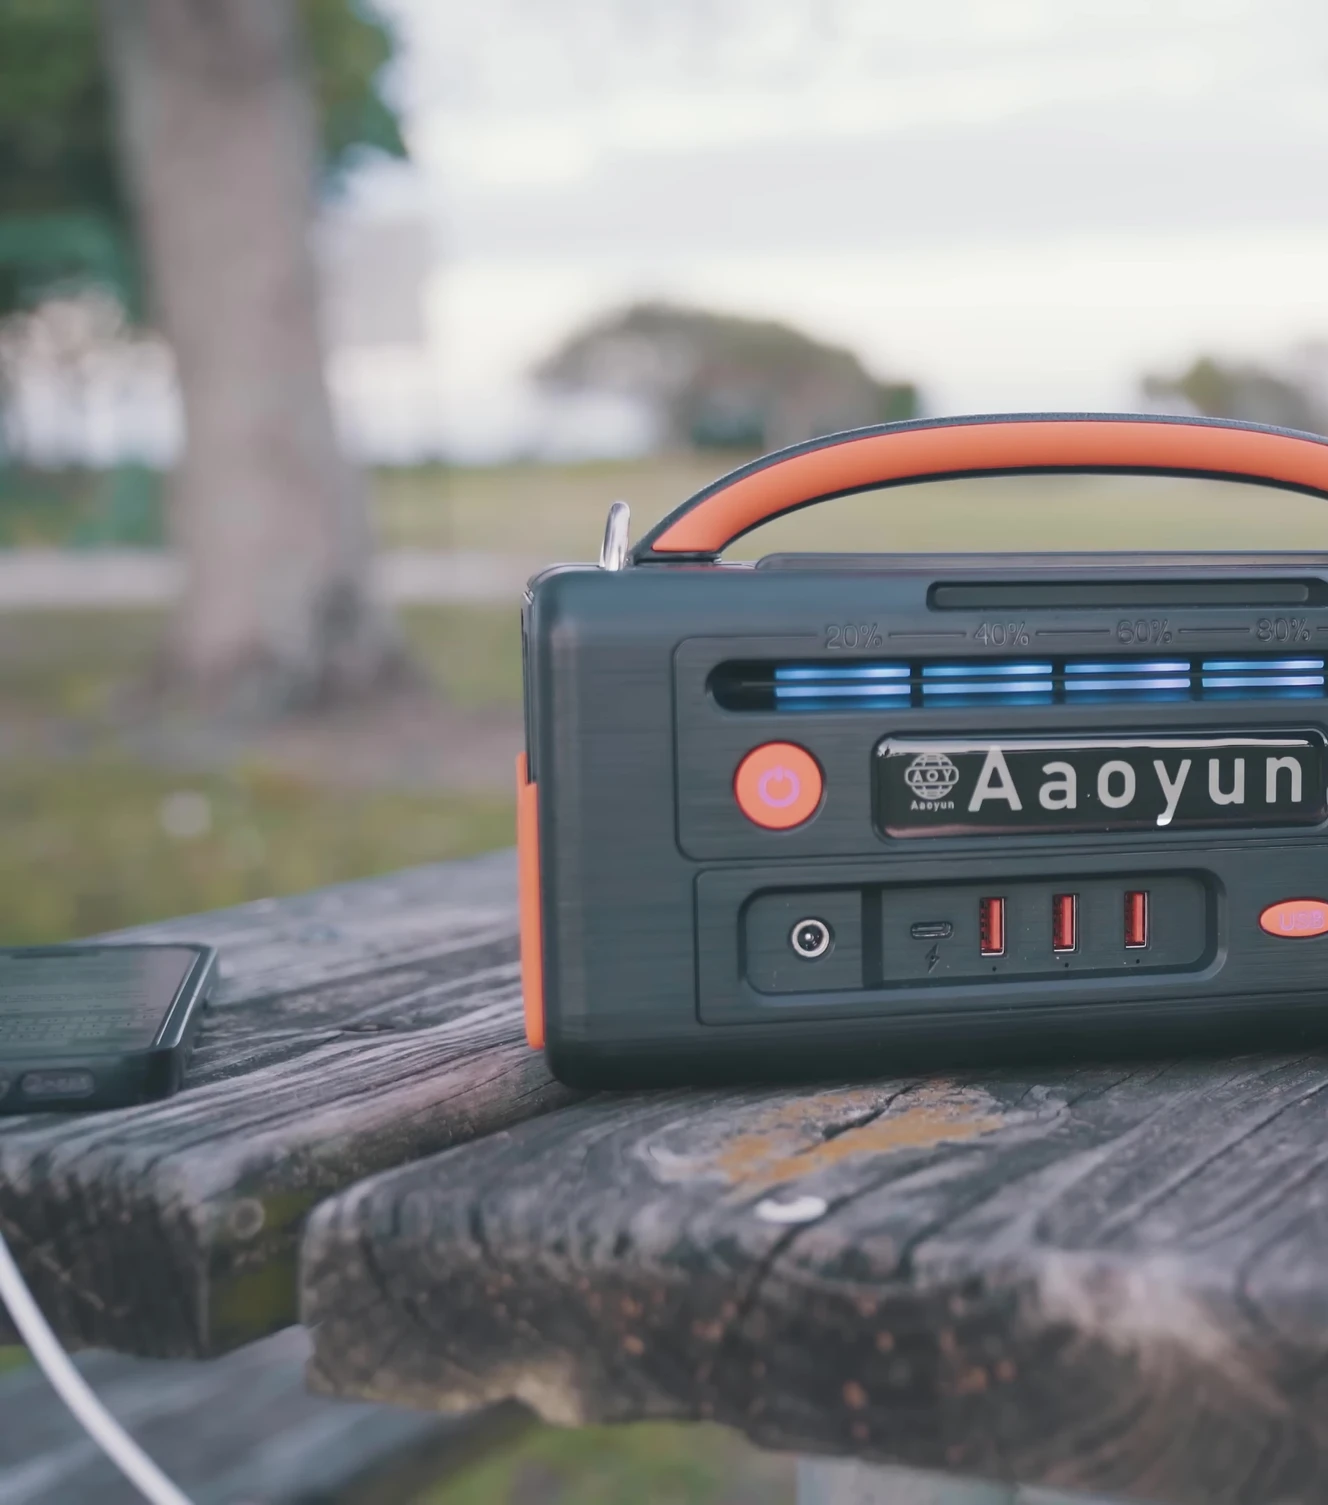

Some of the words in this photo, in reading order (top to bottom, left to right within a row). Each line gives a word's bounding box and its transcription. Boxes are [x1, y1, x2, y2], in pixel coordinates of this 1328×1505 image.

[825, 624, 883, 649] 20%
[973, 622, 1030, 647] 40%
[1116, 619, 1173, 645] 60%
[1256, 617, 1312, 642] 80%
[912, 768, 953, 783] AOY
[968, 745, 1303, 826] Aaoyun
[1280, 910, 1324, 931] USB
